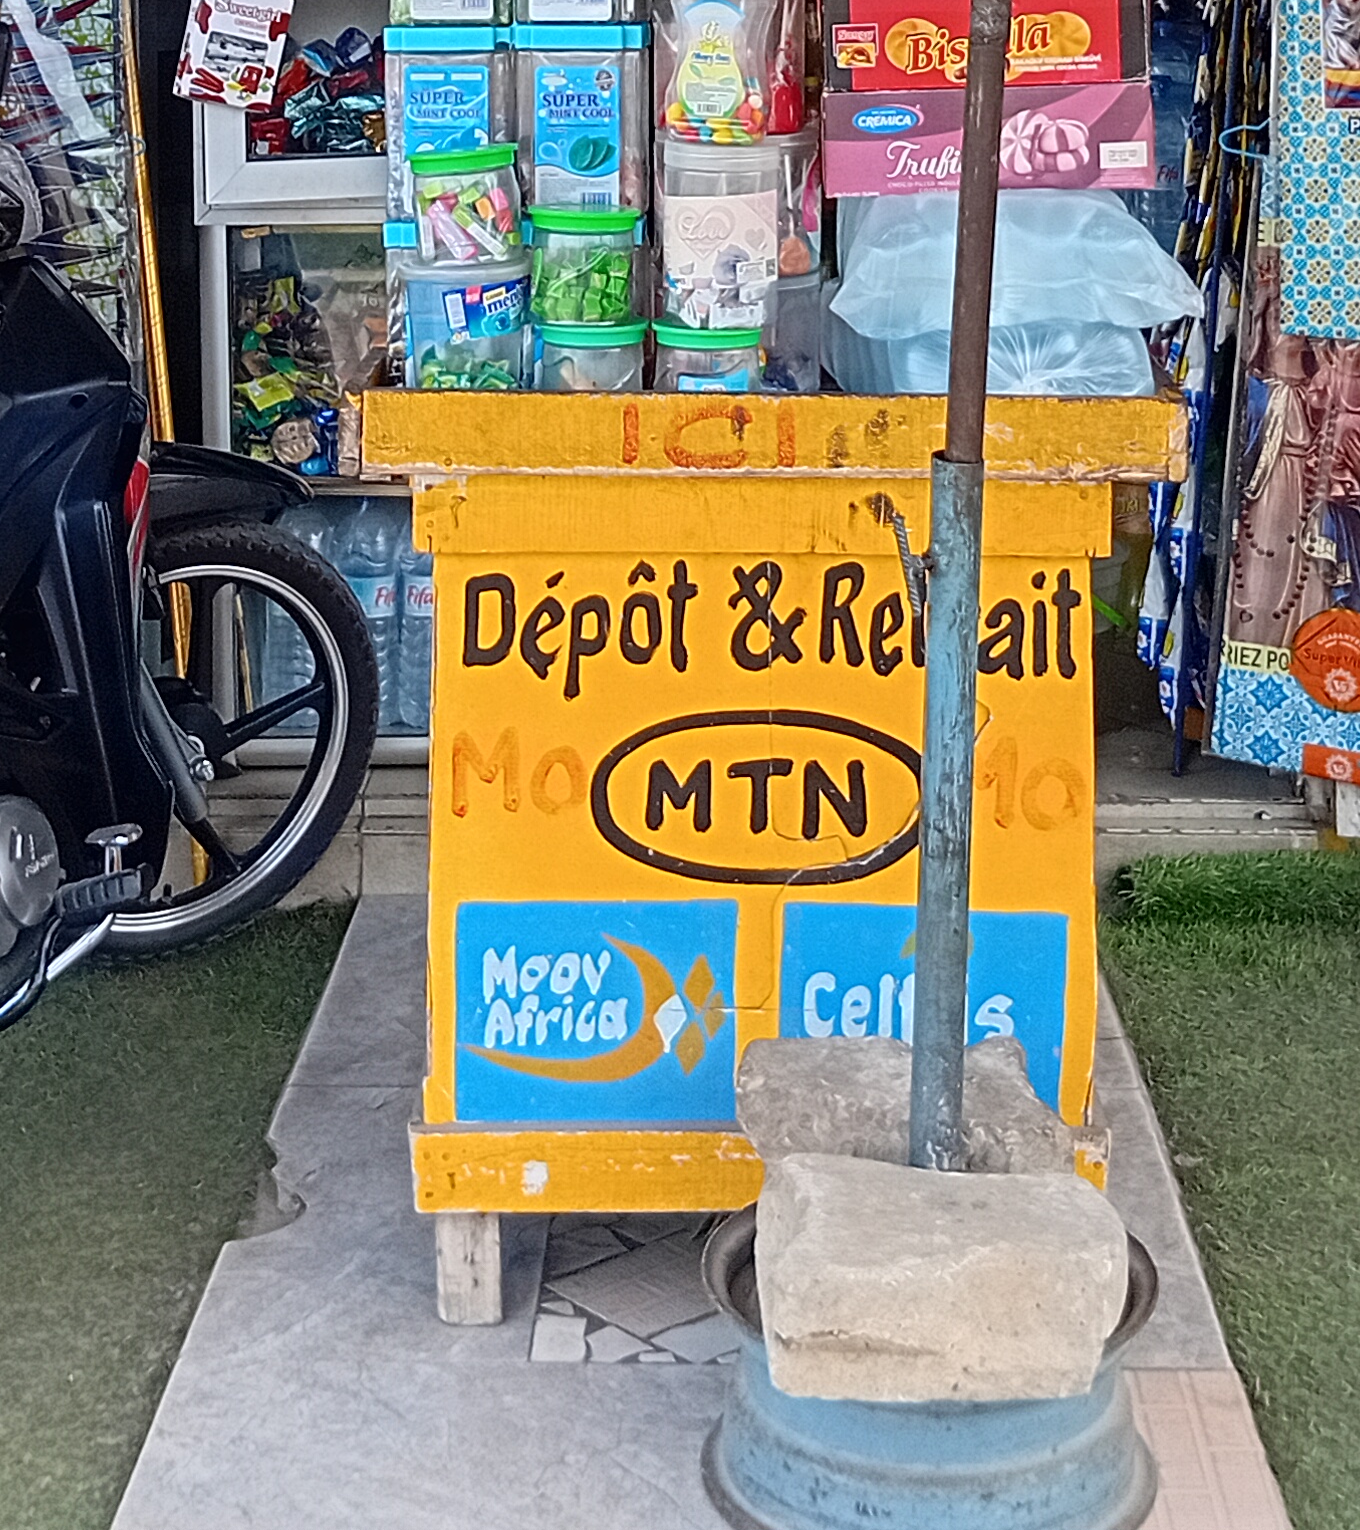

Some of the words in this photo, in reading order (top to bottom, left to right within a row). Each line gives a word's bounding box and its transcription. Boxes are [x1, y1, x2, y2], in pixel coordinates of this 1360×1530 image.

[857, 115, 912, 128] CREMICA
[886, 140, 962, 179] Trufi
[461, 559, 699, 701] Dépôt
[728, 562, 808, 671] &
[819, 560, 1083, 681] Reait
[644, 757, 868, 841] MTN
[481, 943, 611, 1002] Moov
[483, 992, 631, 1049] Africa
